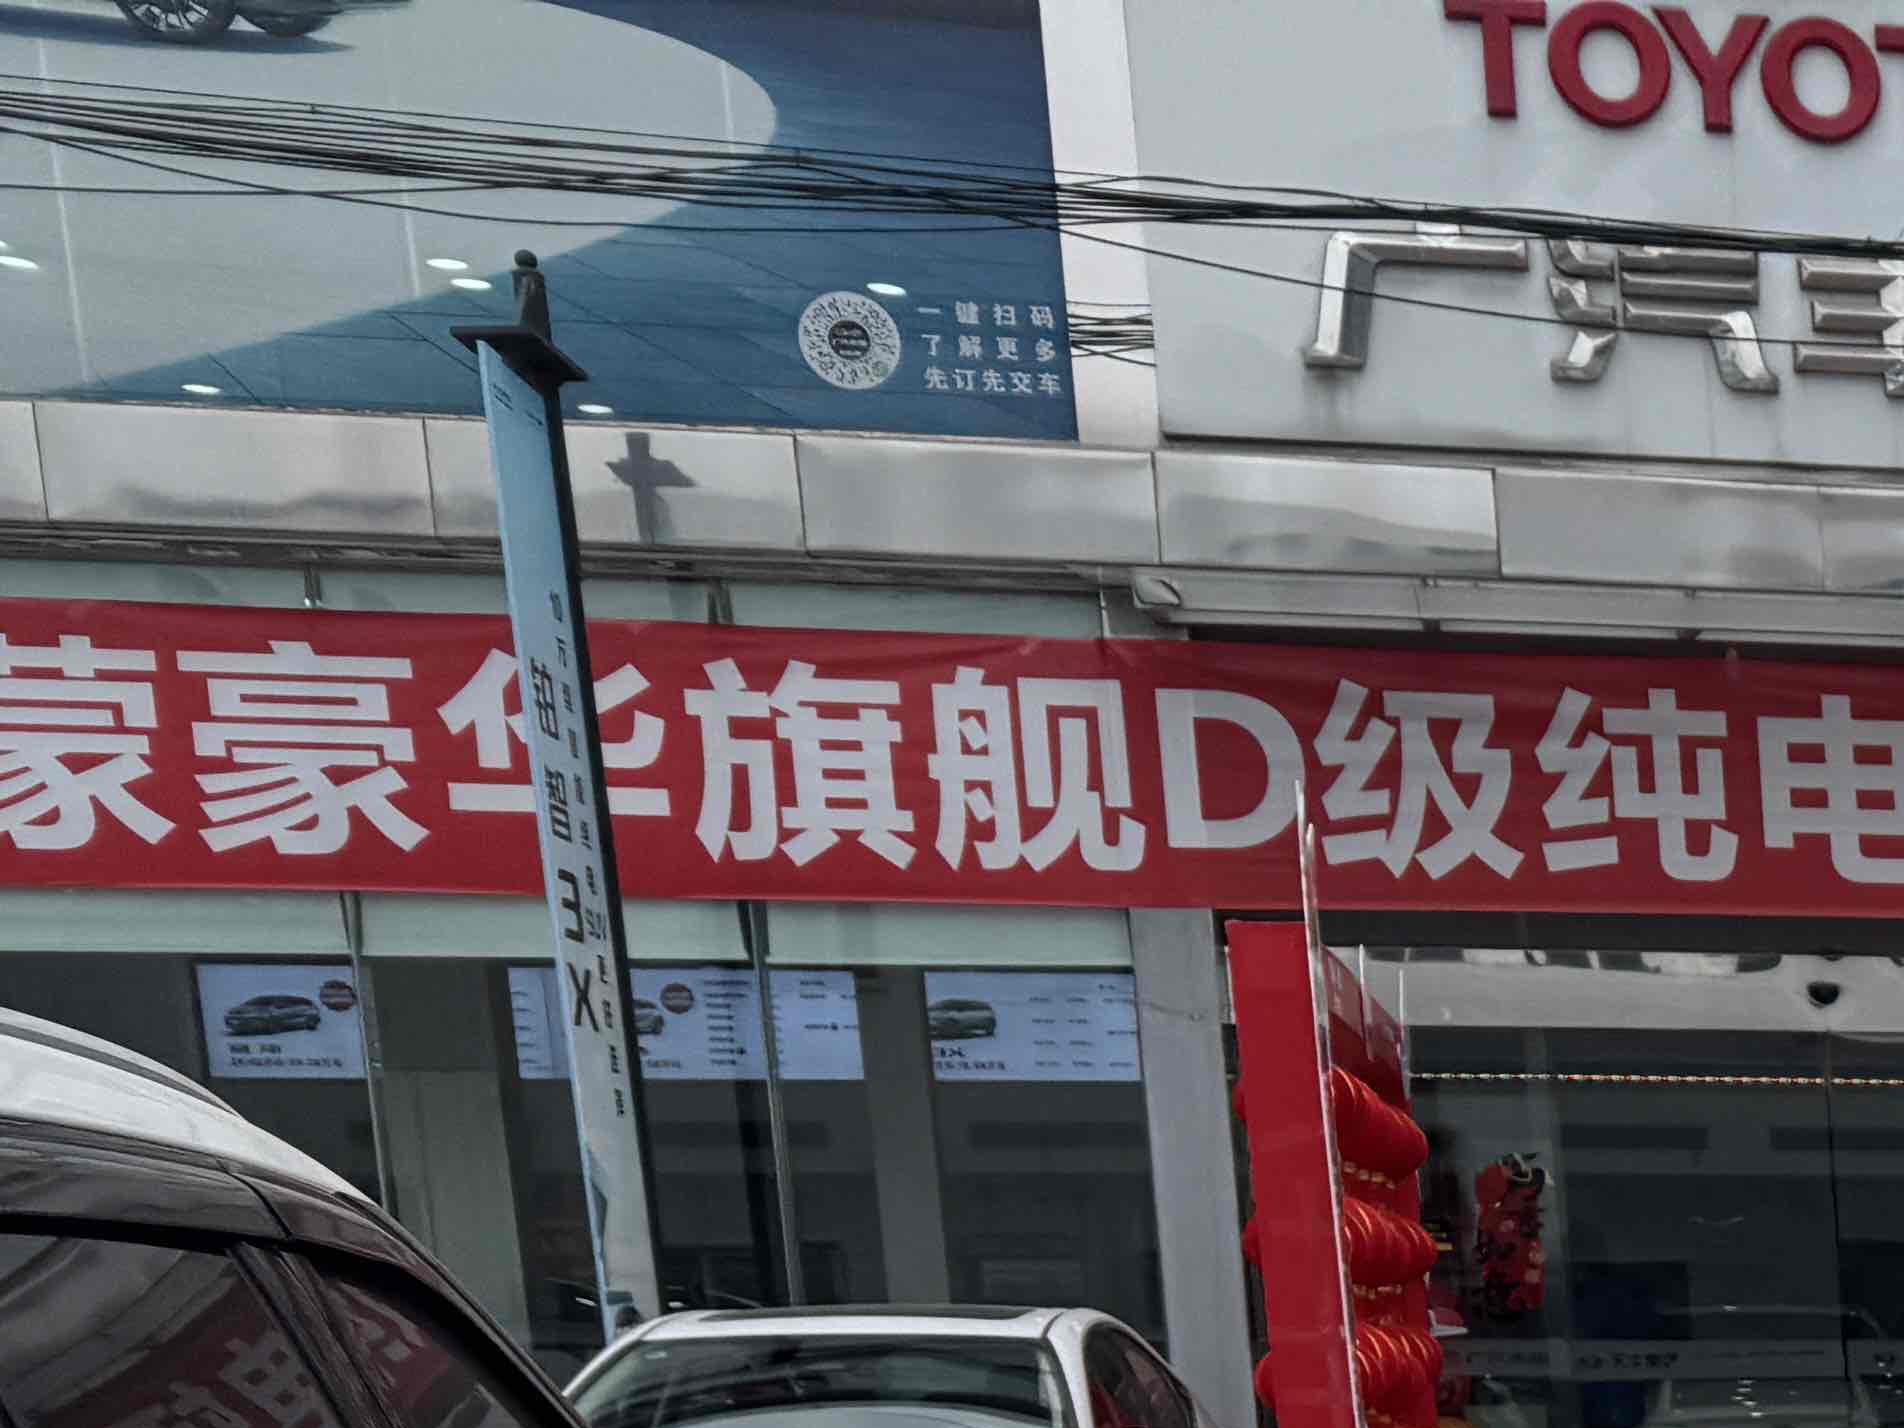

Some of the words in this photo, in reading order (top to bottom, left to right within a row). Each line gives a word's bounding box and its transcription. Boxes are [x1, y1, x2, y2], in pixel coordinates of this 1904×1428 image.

[917, 301, 1054, 329] 一键扫码
[920, 334, 1056, 362] 了解更多
[925, 366, 1063, 395] 先订先交车
